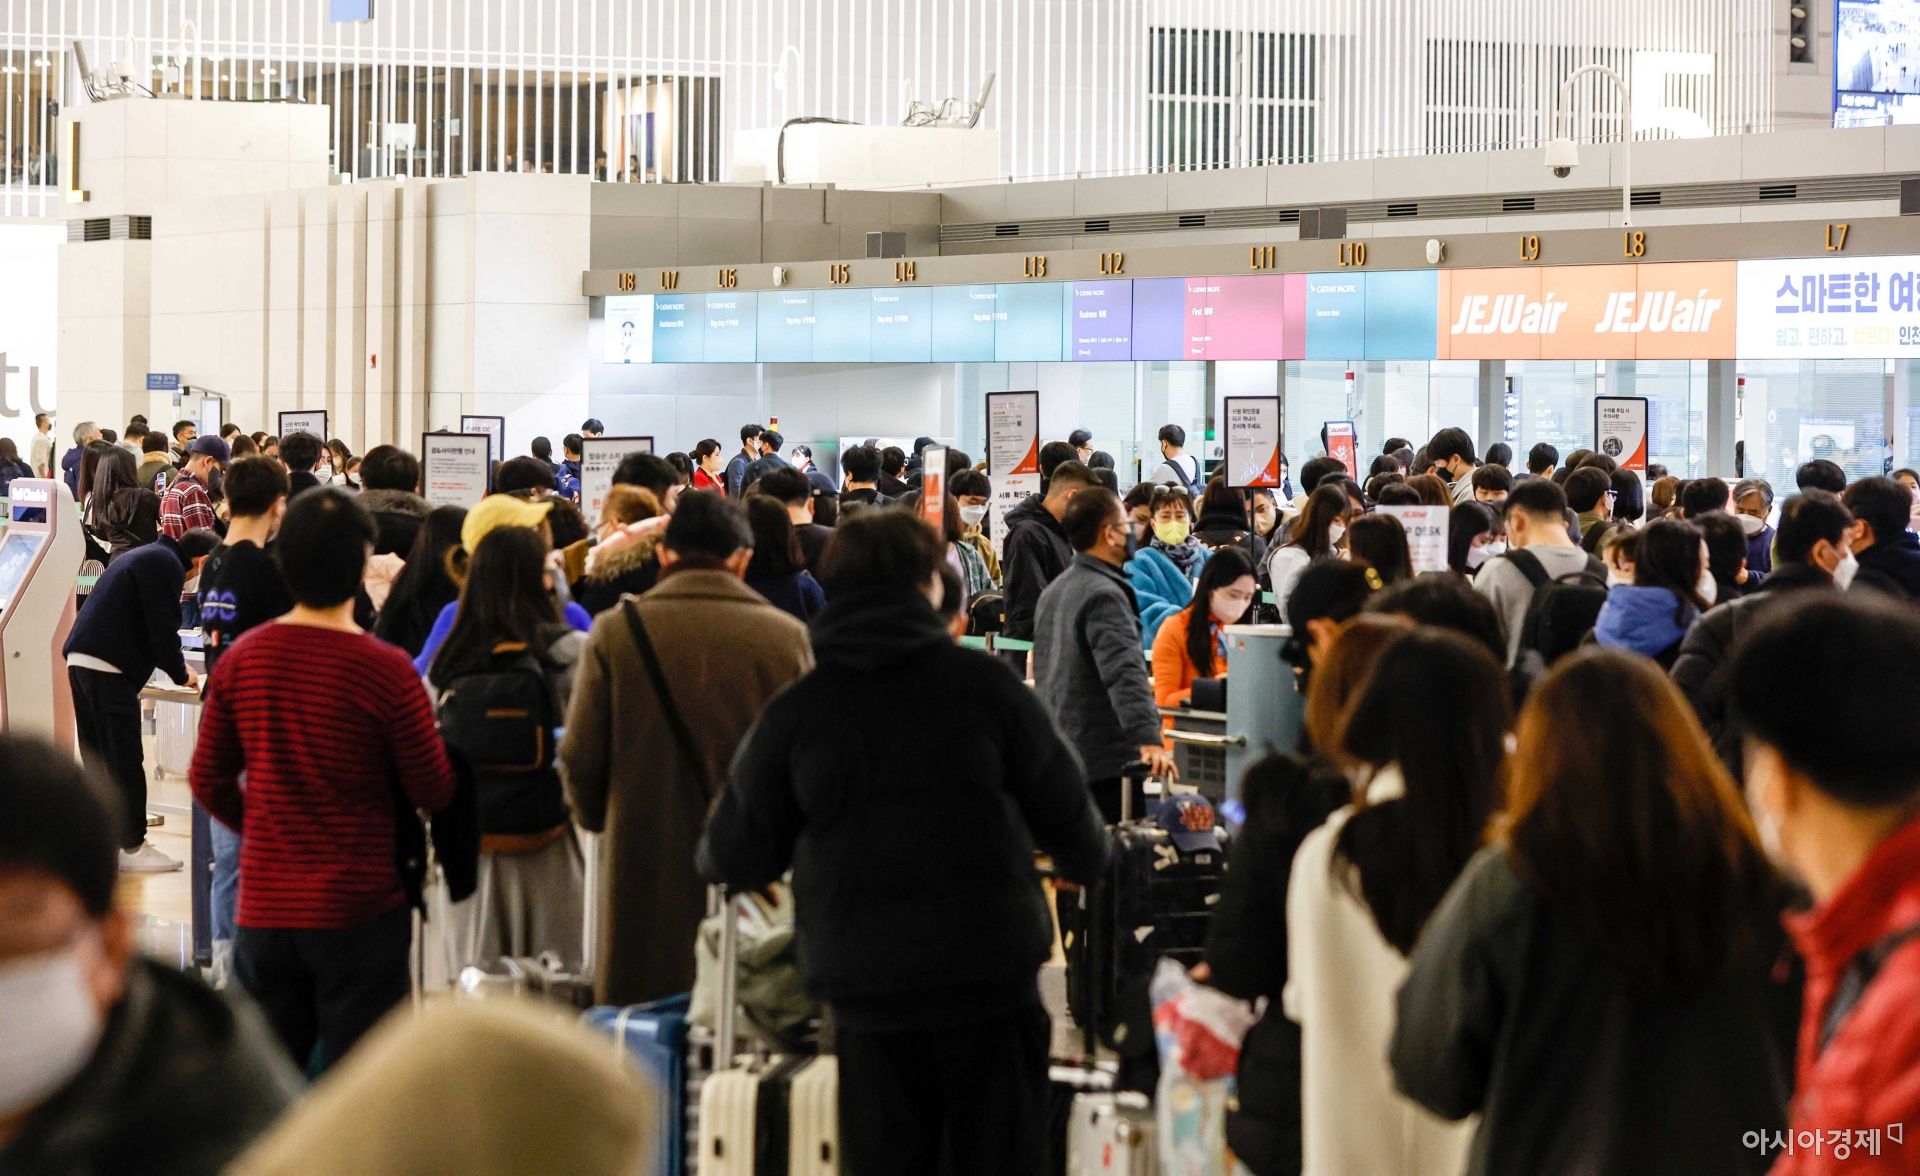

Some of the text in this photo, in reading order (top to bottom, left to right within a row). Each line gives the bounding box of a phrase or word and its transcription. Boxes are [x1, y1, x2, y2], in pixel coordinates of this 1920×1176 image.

[1520, 234, 1540, 260] L9
[1624, 231, 1645, 257] L8
[1825, 224, 1849, 251] L7
[1100, 253, 1124, 274] L12
[1250, 246, 1275, 269] L11
[1338, 242, 1366, 266] L10
[829, 264, 849, 283] L15
[894, 261, 915, 281] L14
[1023, 256, 1046, 277] L13
[617, 272, 635, 291] L18
[660, 271, 678, 289] L17
[717, 269, 736, 288] L16
[1776, 272, 1920, 313] 스마트한 여
[1451, 293, 1568, 334] JEJUair
[1595, 289, 1722, 333] JEJUair
[999, 491, 1010, 499] 서류
[1415, 526, 1441, 536] DESK
